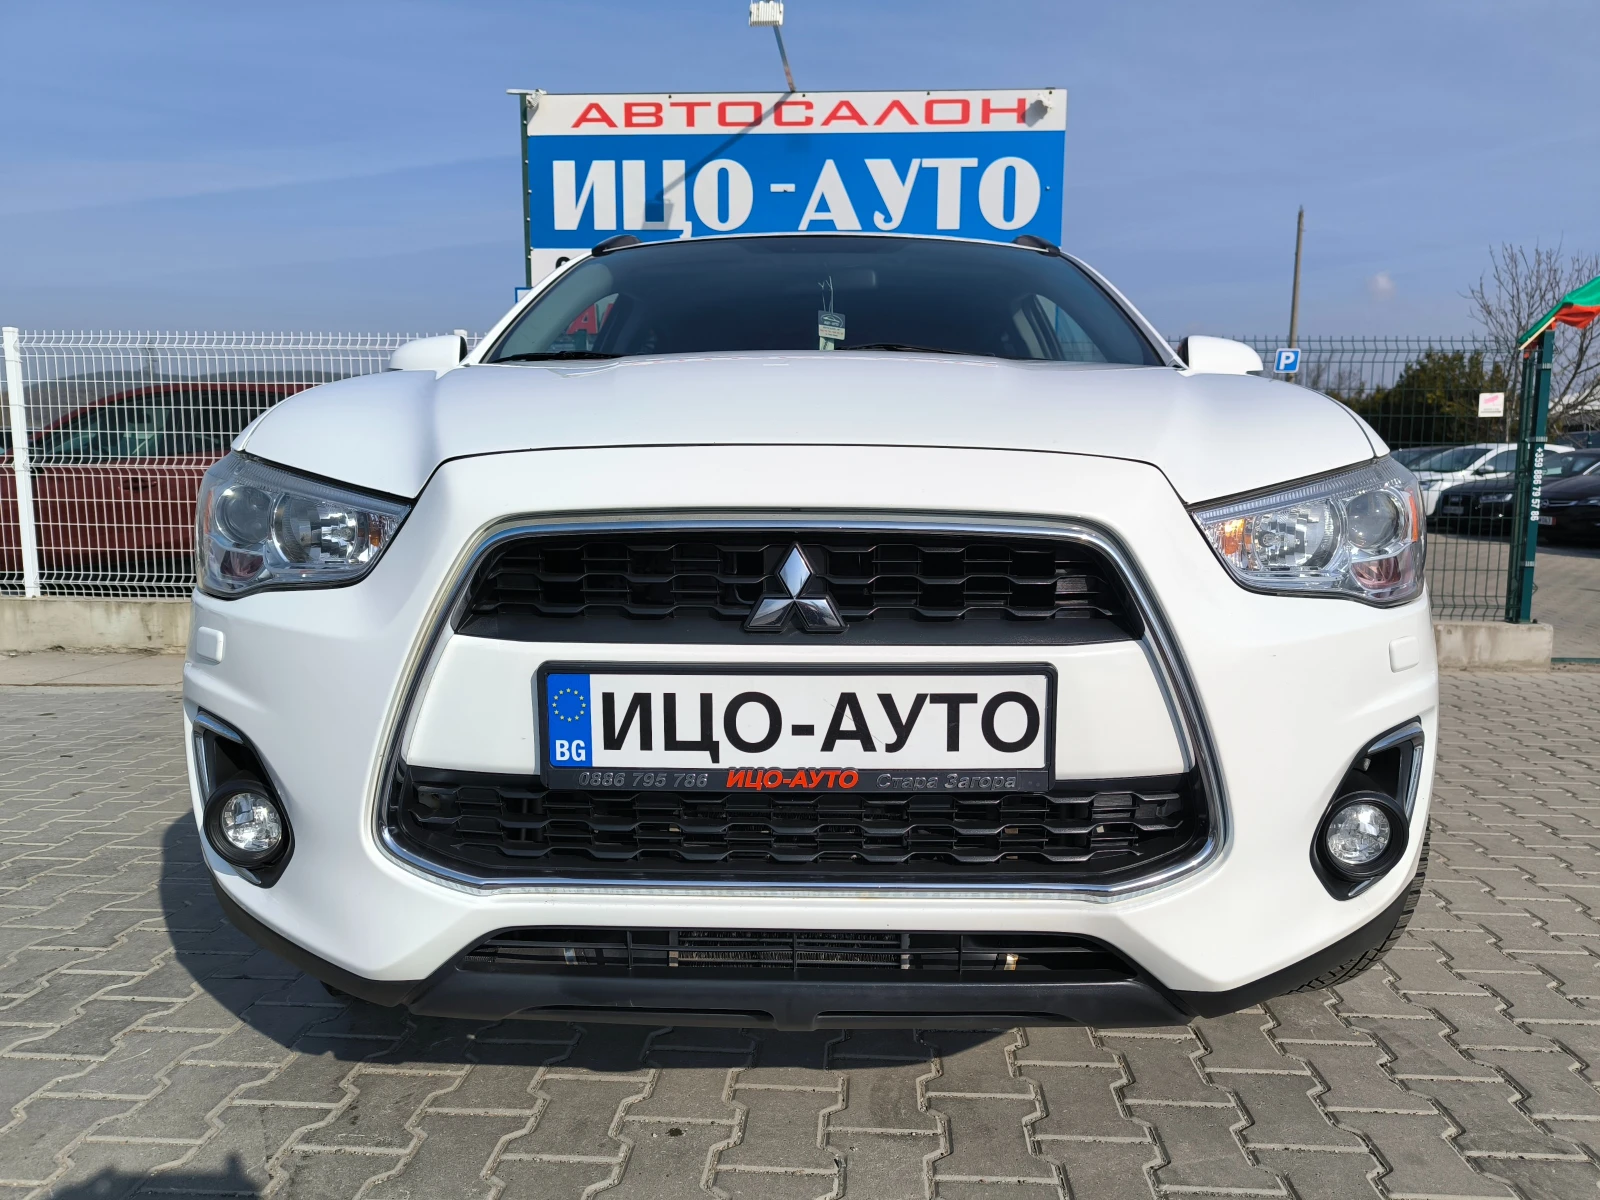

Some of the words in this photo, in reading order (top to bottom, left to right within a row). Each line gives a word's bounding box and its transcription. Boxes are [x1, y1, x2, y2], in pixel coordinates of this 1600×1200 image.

[571, 97, 1027, 129] АВТОСАЛОН
[1279, 351, 1295, 370] P
[1534, 447, 1544, 468] +359
[1532, 469, 1543, 485] 886
[1531, 486, 1541, 497] 79
[1530, 498, 1541, 509] 57
[1529, 510, 1540, 521] 86
[602, 691, 1041, 763] ИЦО-АУТО
[555, 739, 586, 761] BG
[578, 772, 625, 787] 0886
[632, 772, 668, 788] 795
[673, 773, 709, 788] 786
[725, 768, 859, 791] ИЦО-АУТО
[876, 773, 938, 791] Стара
[944, 773, 1016, 791] Загора
